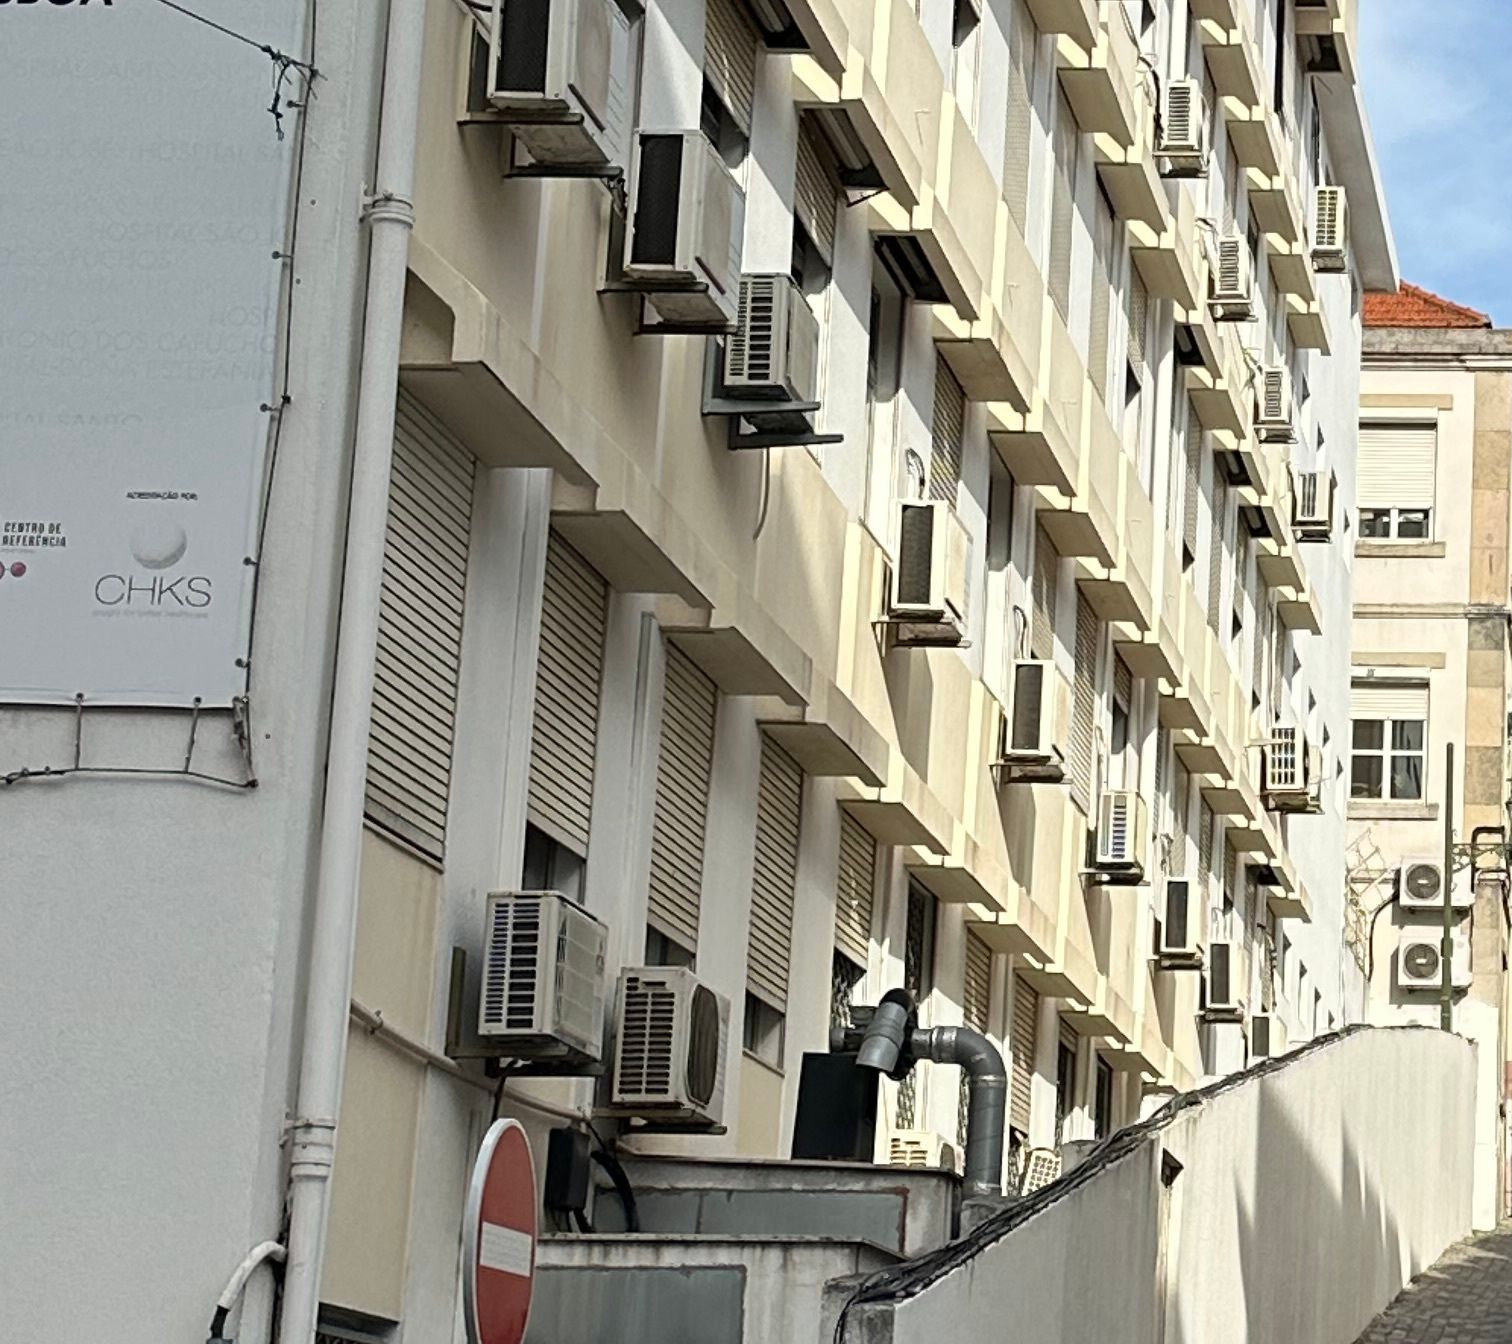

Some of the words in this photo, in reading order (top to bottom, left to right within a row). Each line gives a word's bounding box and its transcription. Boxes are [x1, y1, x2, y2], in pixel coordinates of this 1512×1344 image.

[4, 521, 45, 534] CENTRO
[48, 522, 62, 535] DE
[95, 574, 213, 608] CHKS
